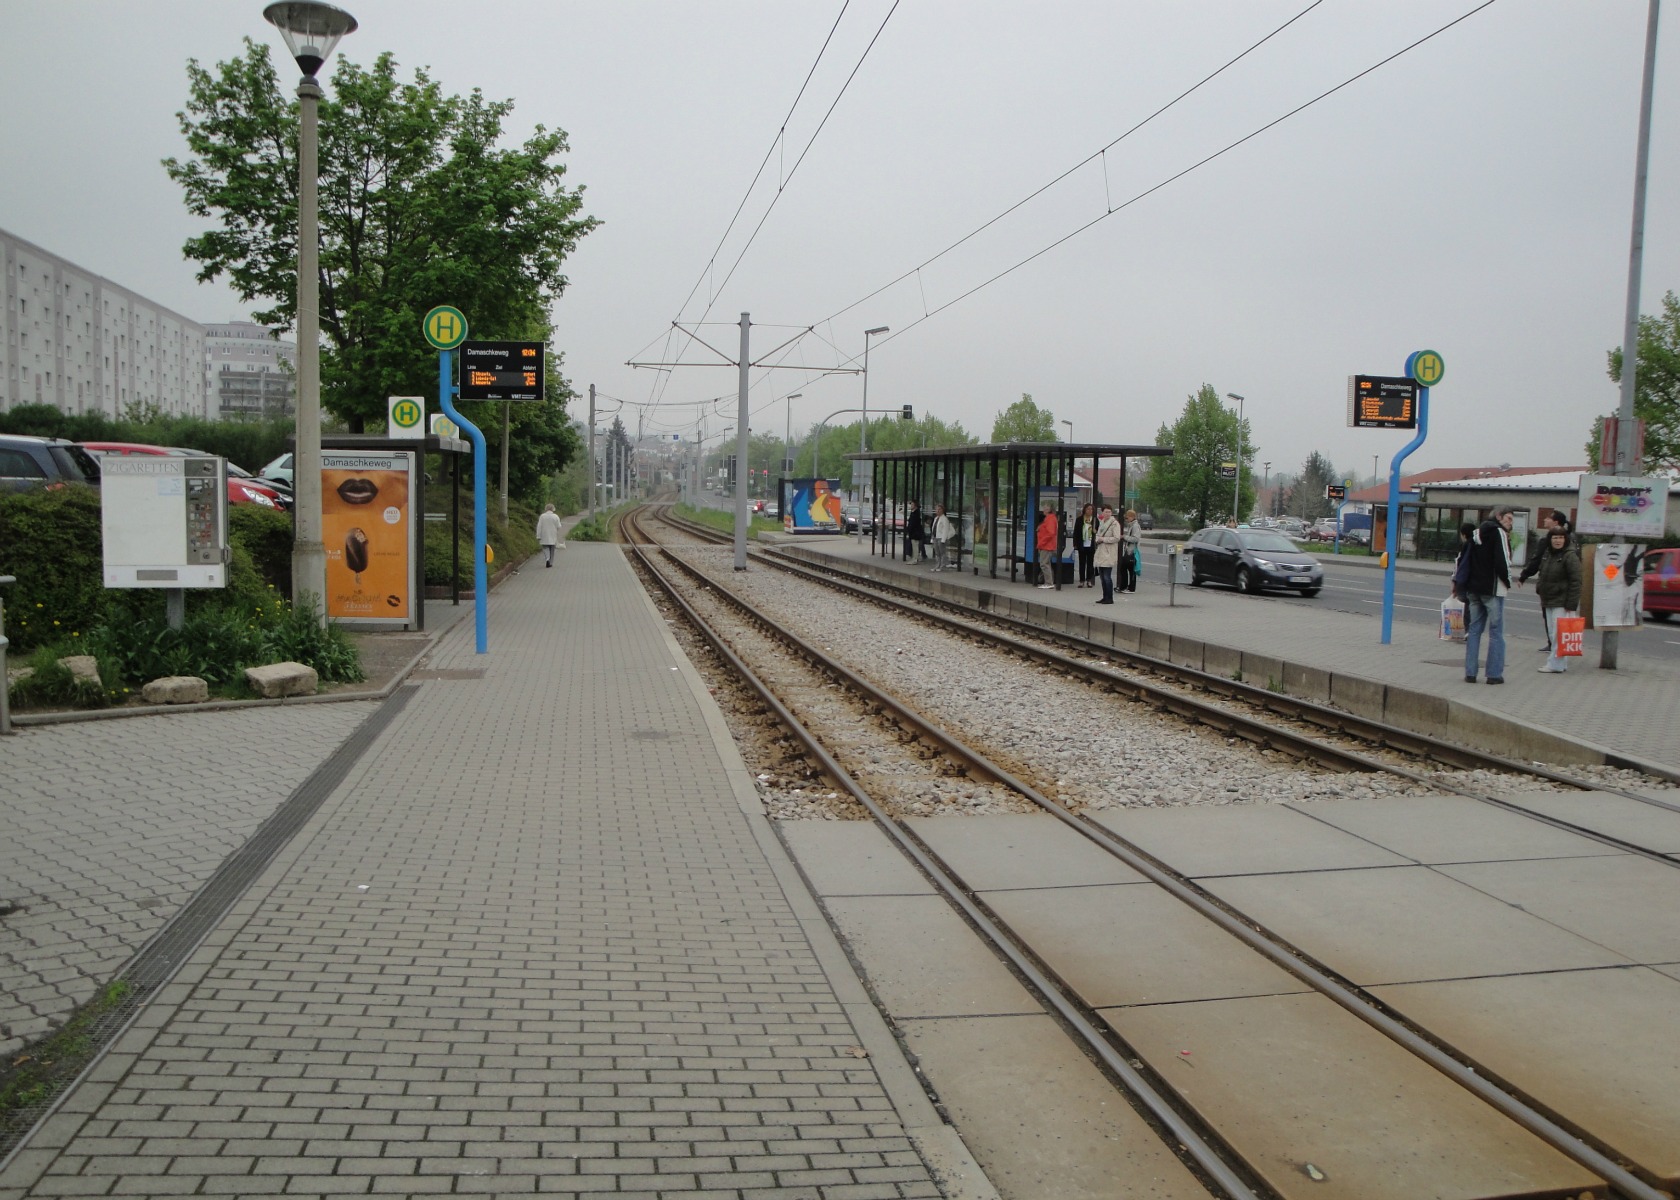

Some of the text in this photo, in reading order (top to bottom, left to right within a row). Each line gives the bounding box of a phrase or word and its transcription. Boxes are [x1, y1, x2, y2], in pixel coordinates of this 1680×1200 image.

[437, 316, 454, 339] H
[467, 349, 509, 357] Damaschkeweg
[1422, 358, 1436, 378] H
[400, 405, 414, 421] H
[109, 462, 179, 473] ZIGARETTEN
[323, 458, 392, 469] Damaschkeweg
